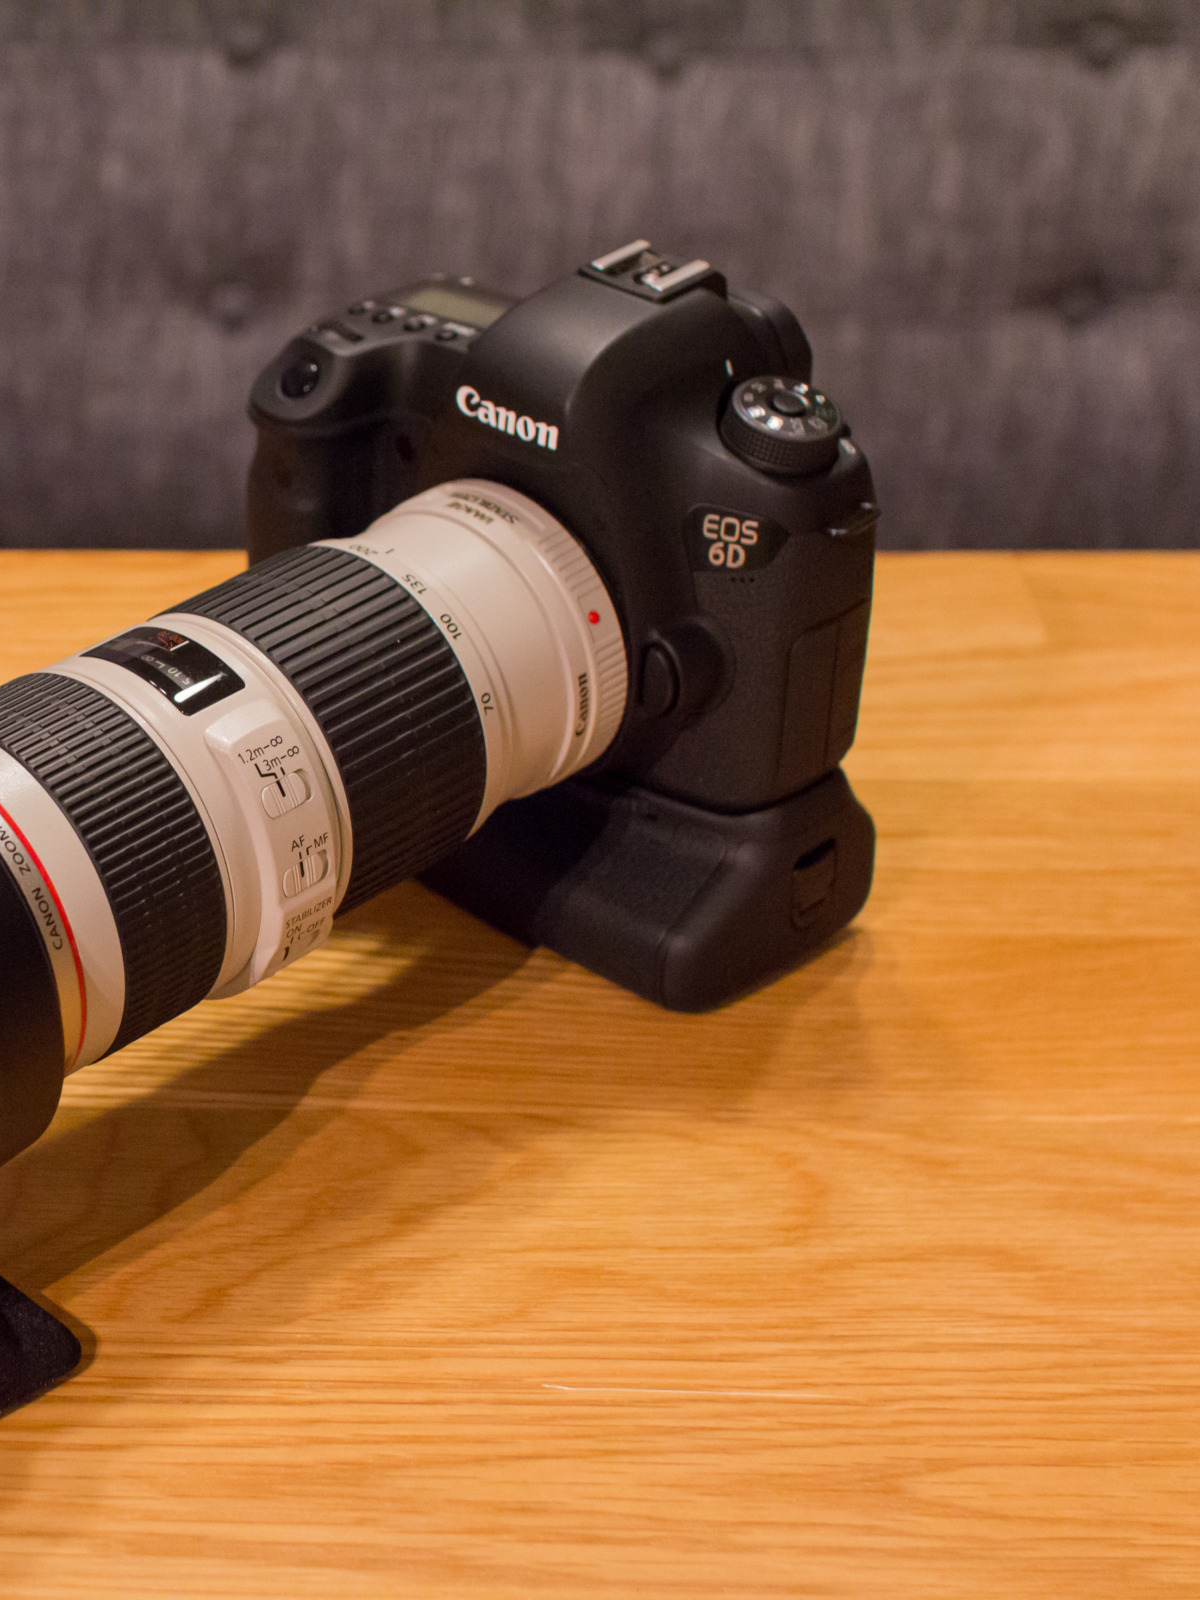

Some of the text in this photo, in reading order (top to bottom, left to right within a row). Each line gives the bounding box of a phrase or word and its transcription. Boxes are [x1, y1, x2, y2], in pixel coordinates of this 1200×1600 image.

[456, 385, 559, 451] Canon
[703, 513, 760, 545] EOS
[708, 541, 746, 569] 6D
[403, 573, 428, 595] 135
[440, 613, 462, 640] 100
[481, 692, 494, 716] 70
[575, 672, 588, 737] Canon
[291, 832, 329, 852] AF MF
[31, 887, 63, 950] CANON
[285, 896, 333, 929] STABILIZER
[286, 924, 302, 938] ON
